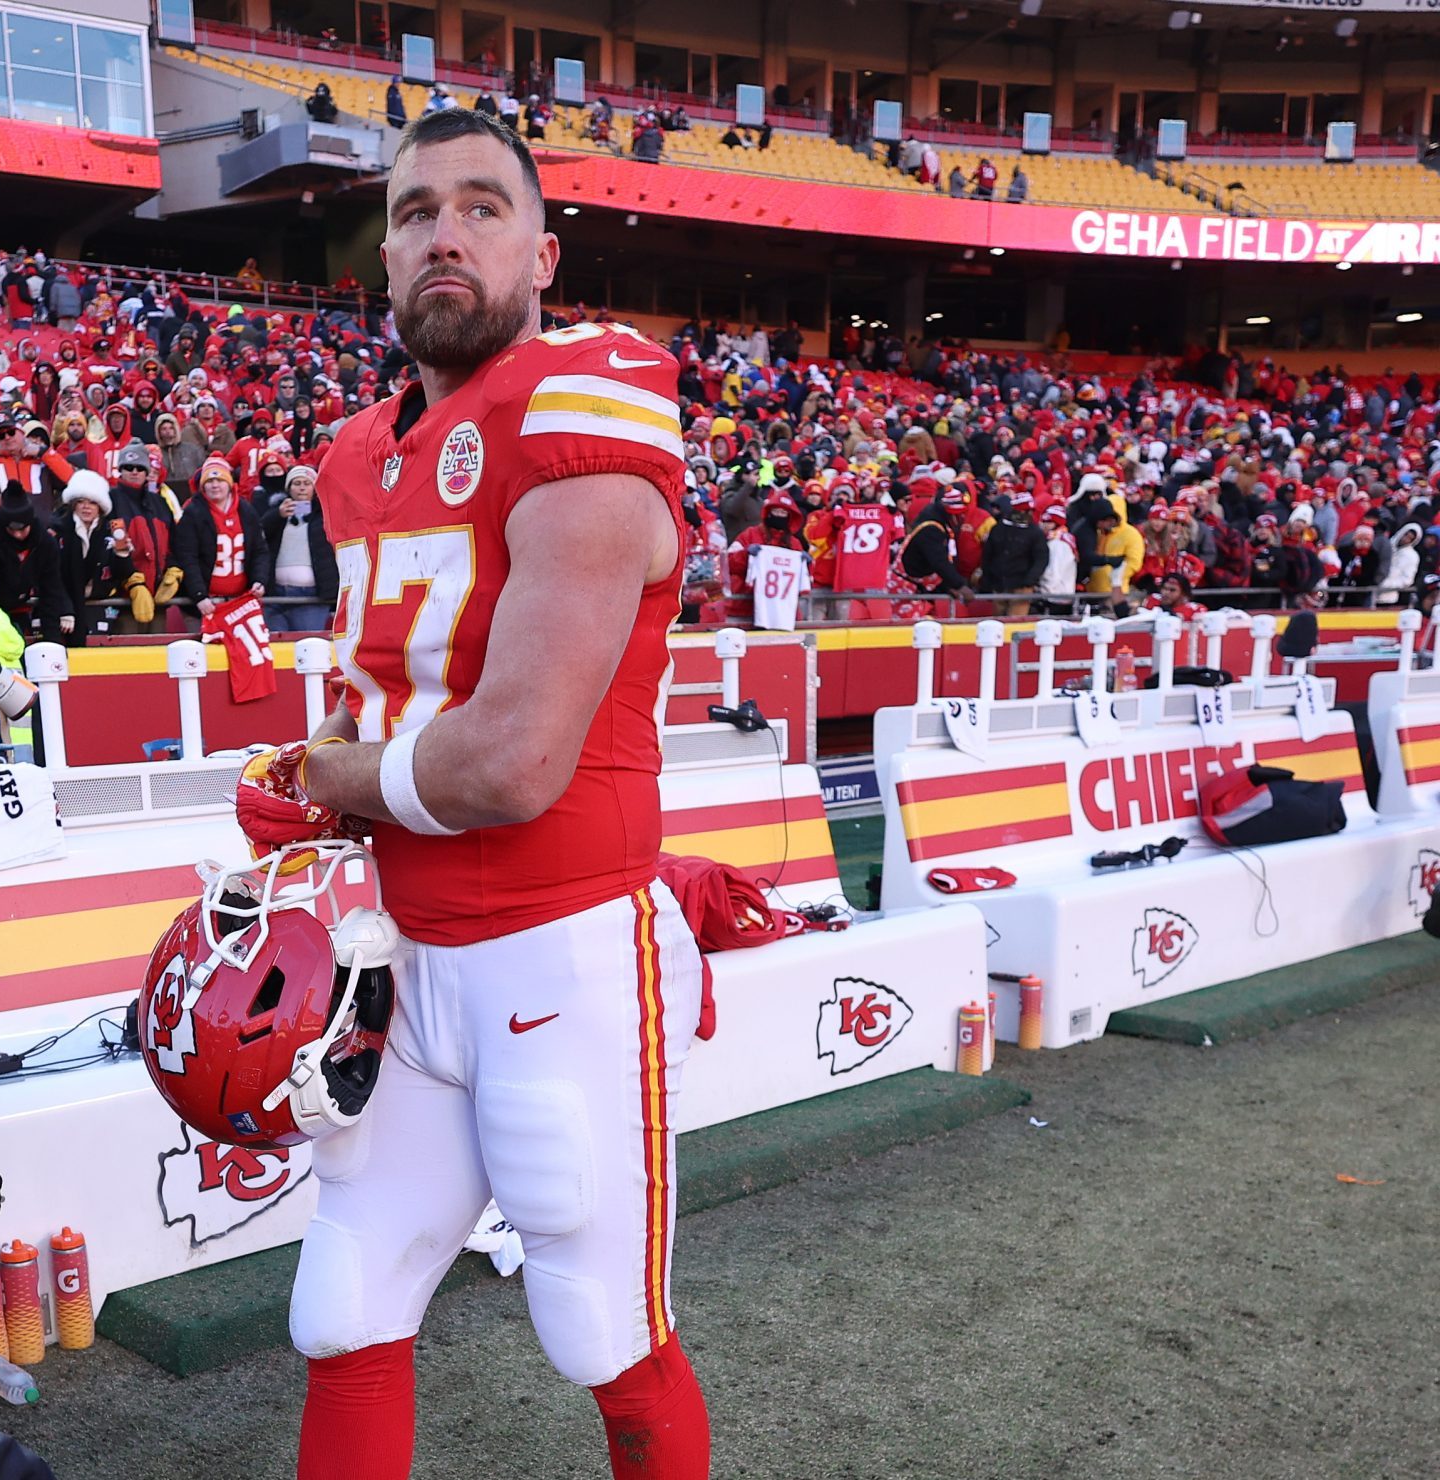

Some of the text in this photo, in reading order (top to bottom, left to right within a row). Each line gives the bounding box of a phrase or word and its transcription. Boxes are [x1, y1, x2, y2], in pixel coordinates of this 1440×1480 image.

[1071, 210, 1190, 258] GEHA
[1198, 216, 1314, 262] FIELD
[1316, 229, 1354, 255] AT
[843, 522, 884, 554] 18
[764, 571, 796, 600] 87
[233, 614, 274, 667] 15
[822, 784, 862, 801] AM TENT
